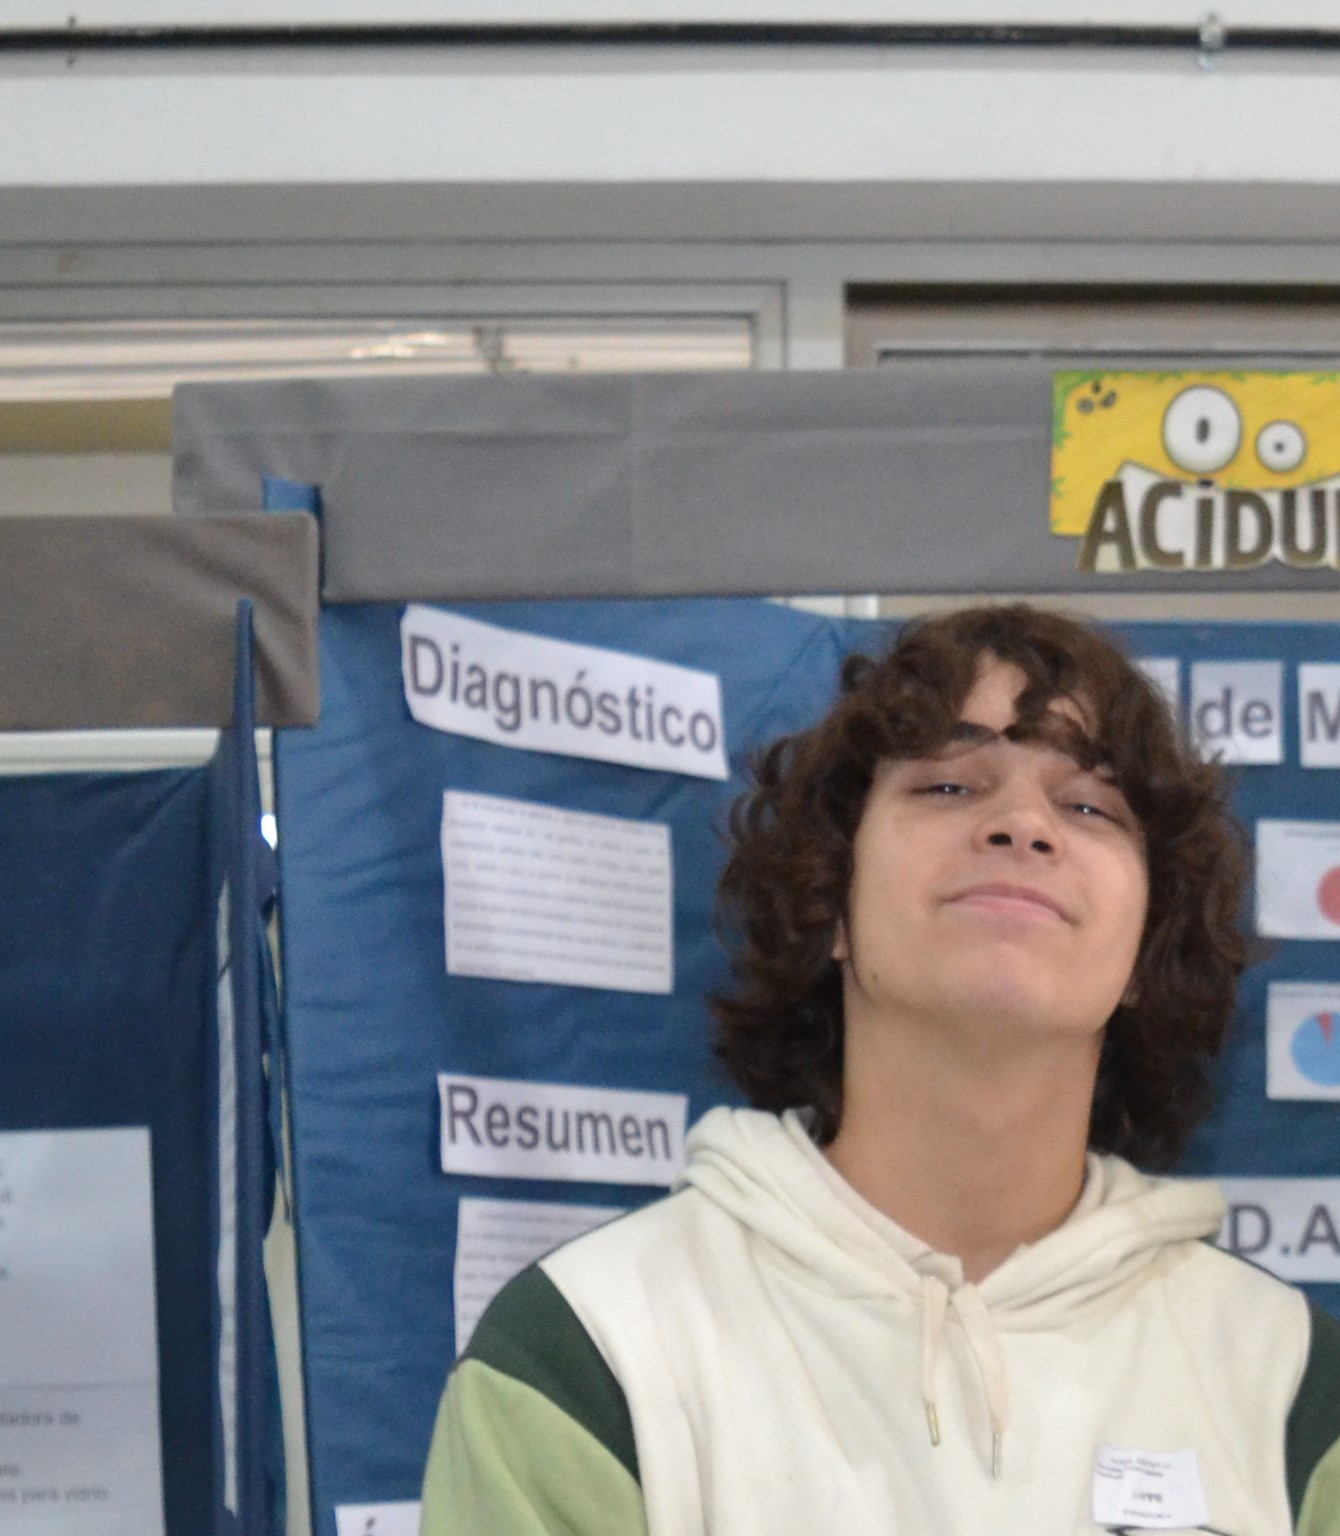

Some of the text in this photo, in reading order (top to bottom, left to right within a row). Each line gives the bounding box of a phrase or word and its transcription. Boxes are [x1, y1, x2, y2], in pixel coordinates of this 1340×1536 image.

[408, 634, 717, 753] Diagnóstico
[1197, 687, 1275, 739] de
[446, 1084, 672, 1161] Resumen
